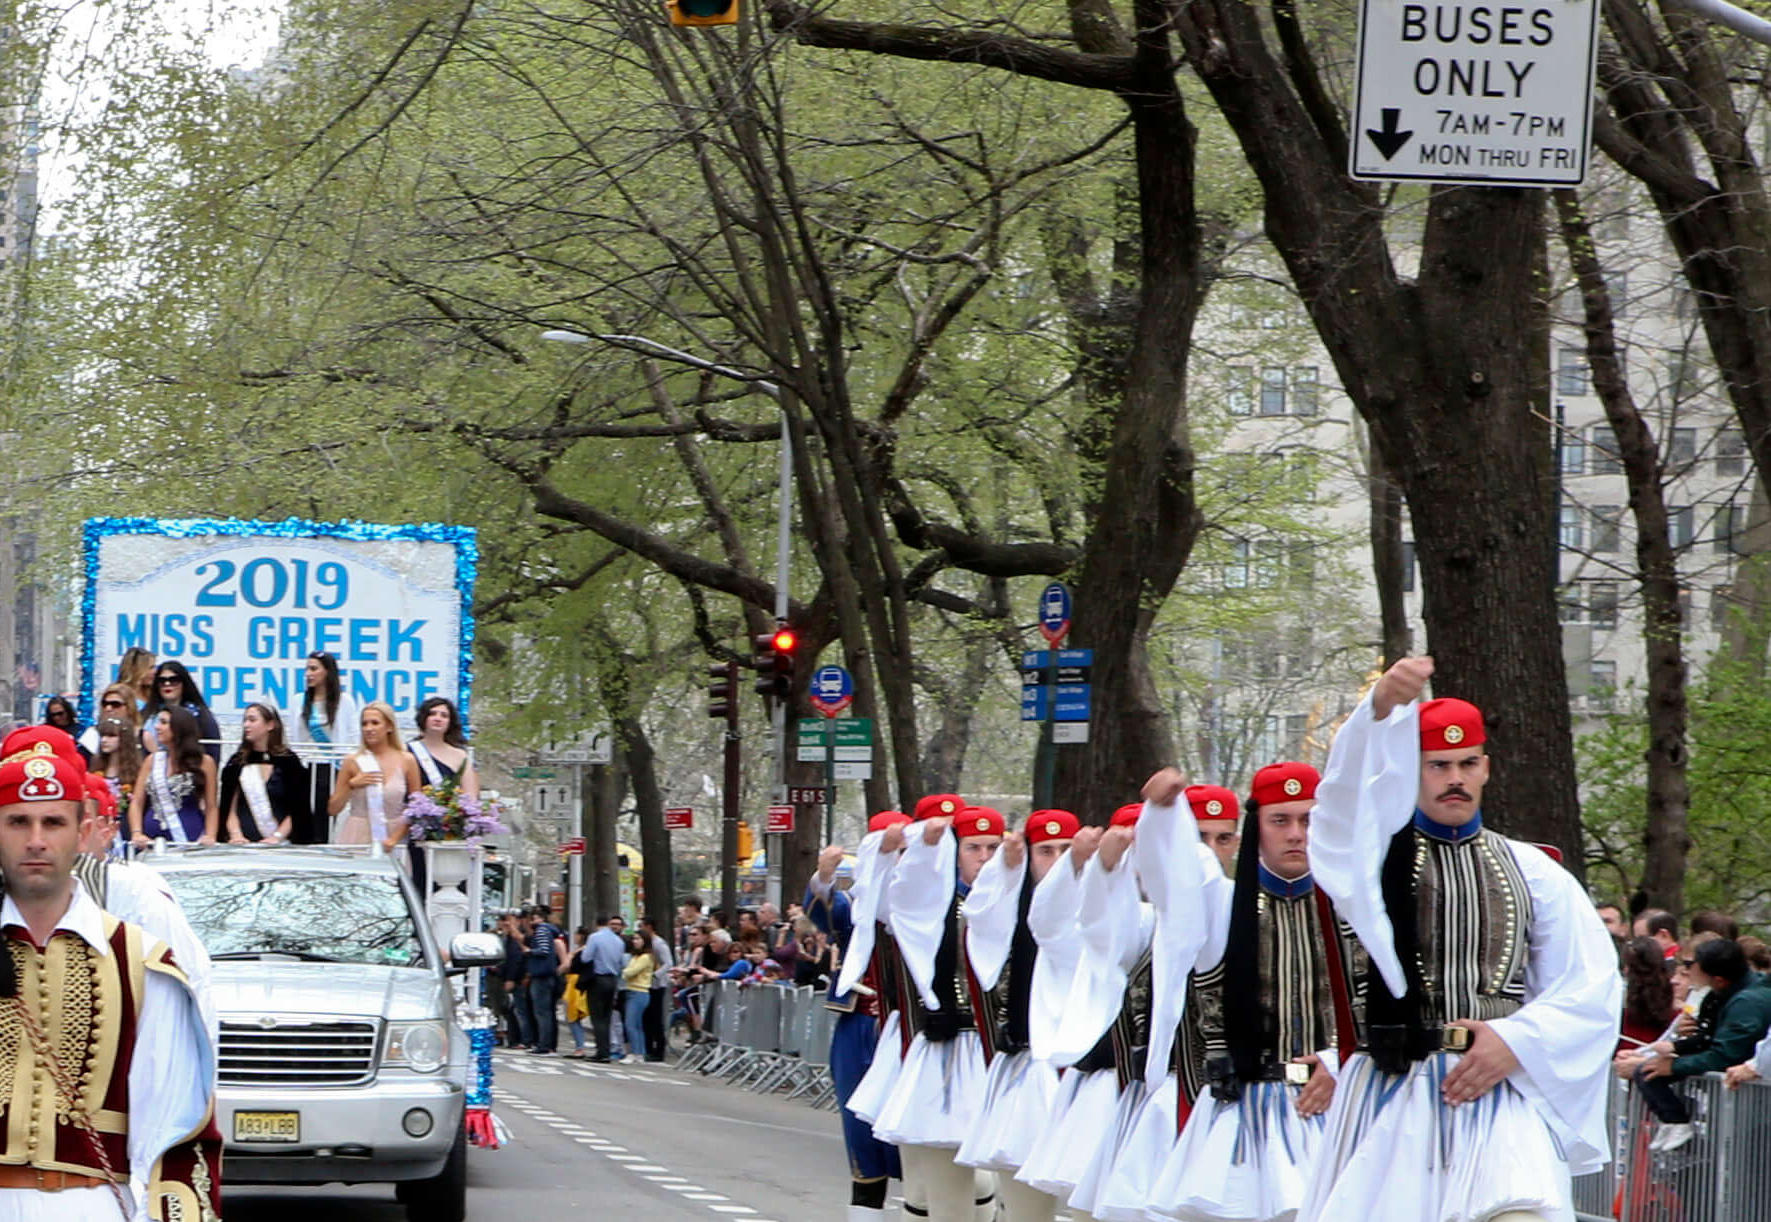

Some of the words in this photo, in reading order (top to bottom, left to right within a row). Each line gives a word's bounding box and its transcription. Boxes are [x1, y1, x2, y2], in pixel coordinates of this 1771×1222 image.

[1401, 4, 1554, 47] BUSES
[1414, 57, 1536, 98] ONLY
[1435, 109, 1566, 138] 7AM-7PM
[1418, 143, 1471, 167] MON
[1478, 149, 1530, 169] THRU
[1539, 147, 1577, 170] FRI
[194, 556, 350, 611] 2019
[116, 613, 215, 658] MISS
[248, 614, 429, 663] GREEK
[801, 789, 816, 803] 61
